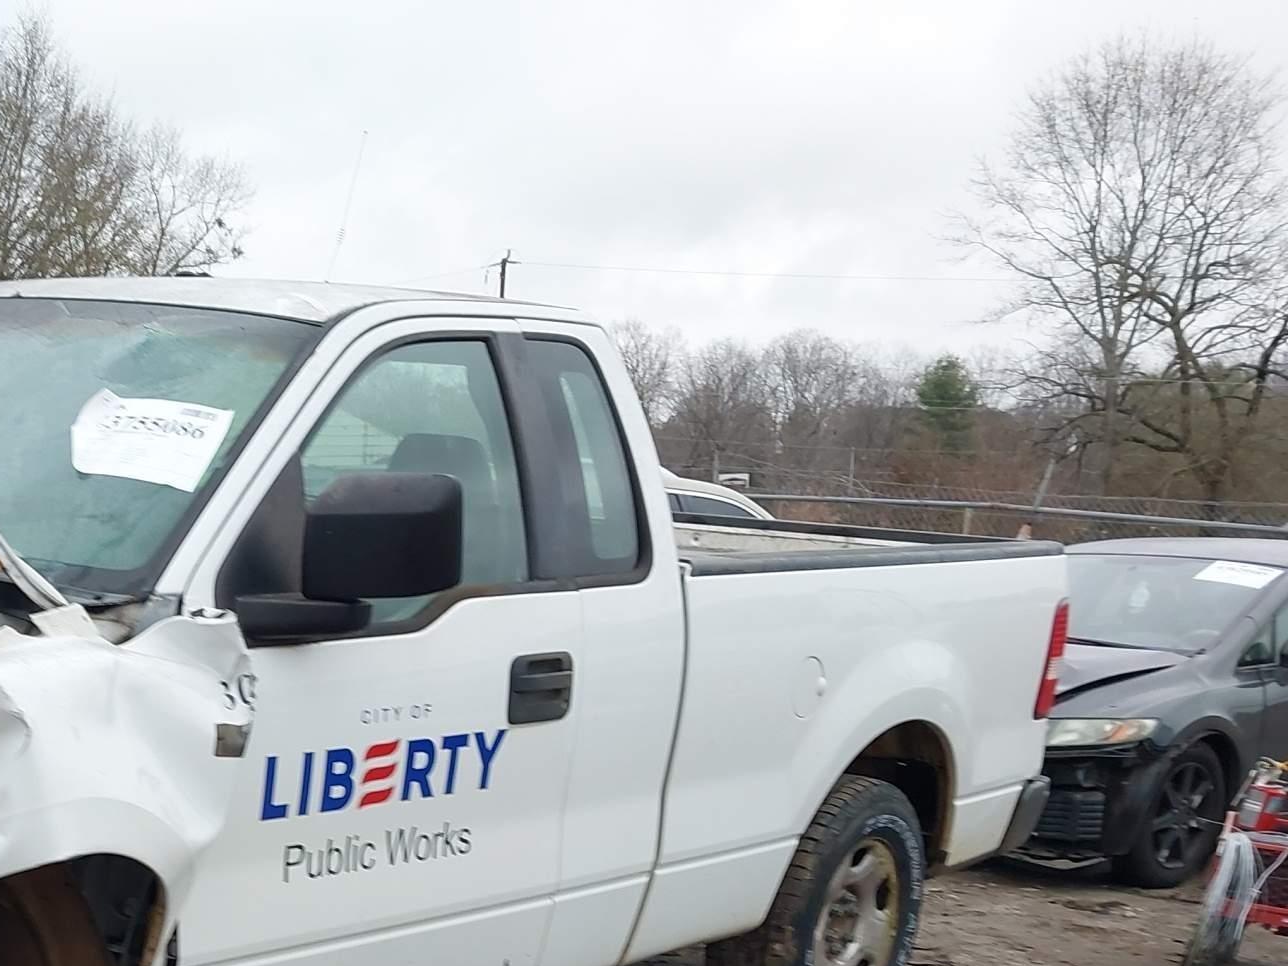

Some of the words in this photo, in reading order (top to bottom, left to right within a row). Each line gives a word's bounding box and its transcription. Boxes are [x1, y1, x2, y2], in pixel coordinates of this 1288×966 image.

[360, 707, 403, 726] CITY
[410, 704, 433, 721] OF
[261, 728, 506, 821] LIBERTY
[282, 834, 377, 883] Public
[386, 822, 472, 866] Works
